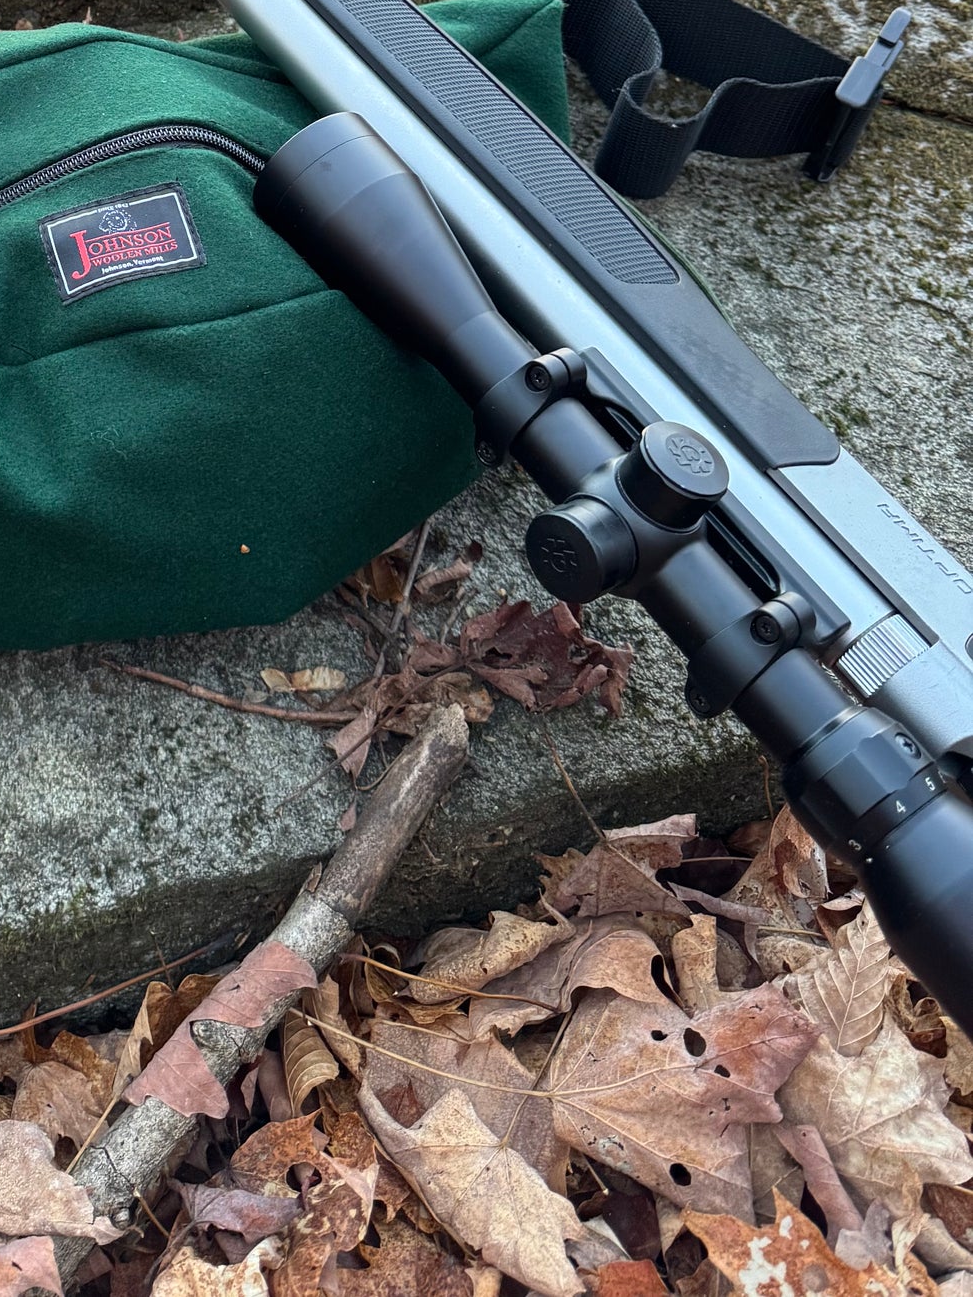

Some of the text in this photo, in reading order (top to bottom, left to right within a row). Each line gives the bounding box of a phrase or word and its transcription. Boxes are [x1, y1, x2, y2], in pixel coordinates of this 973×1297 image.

[69, 226, 172, 280] JOHNSON
[91, 241, 179, 267] WOOLEN MILLS
[101, 255, 165, 275] Johnson, Vermont
[876, 503, 973, 595] OPTIMA
[848, 839, 862, 852] 3
[895, 799, 907, 813] 4
[924, 776, 936, 791] 5
